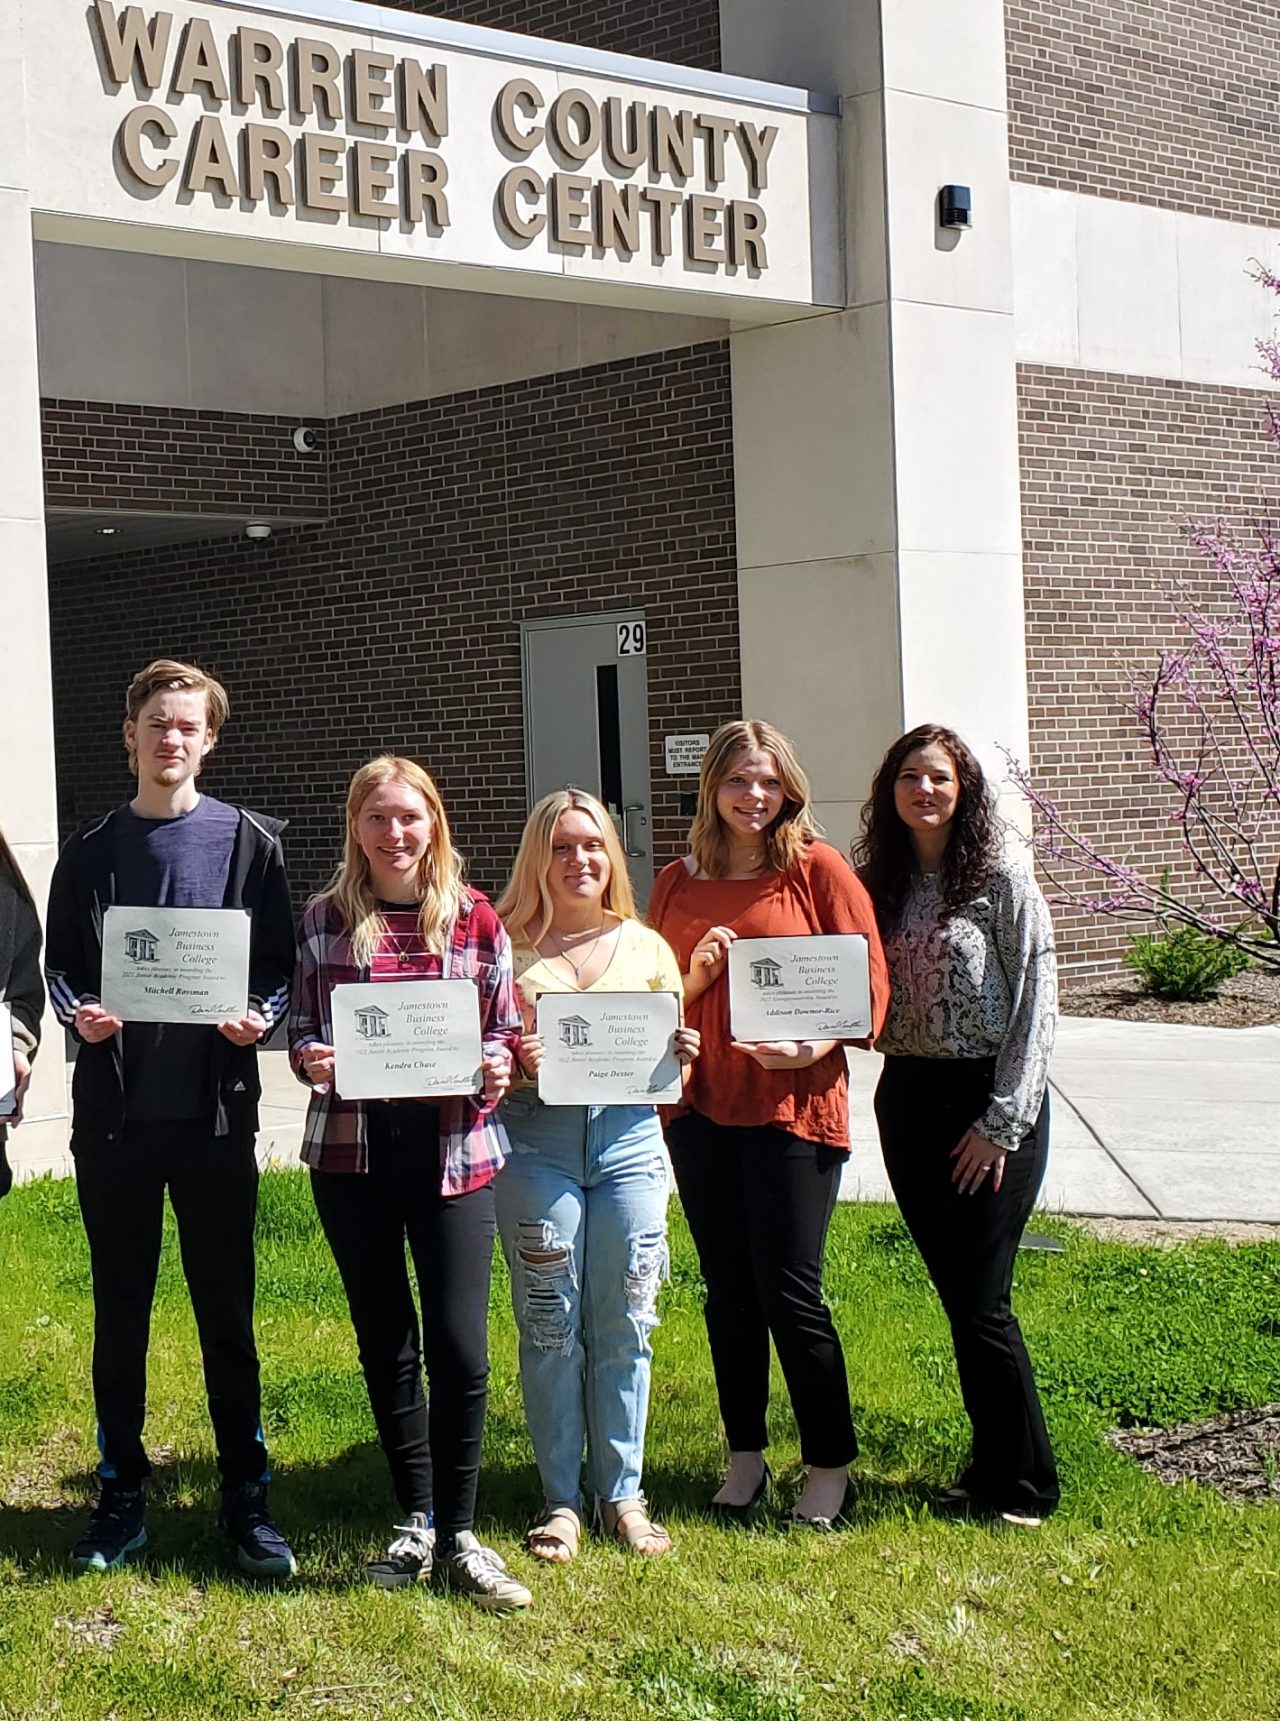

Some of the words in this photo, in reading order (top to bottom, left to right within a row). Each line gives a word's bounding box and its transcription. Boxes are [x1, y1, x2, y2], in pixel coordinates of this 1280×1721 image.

[94, 0, 448, 137] WARREN
[497, 78, 779, 190] COUNTY
[122, 105, 451, 227] CAREER
[500, 165, 769, 269] CENTER
[618, 623, 645, 655] 29
[674, 739, 700, 747] VISITORS
[168, 927, 220, 938] Jamestown
[175, 941, 215, 951] Business
[182, 953, 218, 965] College
[790, 954, 839, 963] Jamestown
[798, 966, 836, 974] Business
[805, 976, 839, 987] College
[143, 986, 174, 995] Mitchell
[398, 1001, 448, 1011] Jamestown
[406, 1014, 445, 1023] Business
[600, 1012, 649, 1021] Jamestown
[413, 1026, 449, 1037] College
[607, 1024, 645, 1034] Business
[614, 1037, 648, 1047] College
[384, 1062, 411, 1070] Kendra
[413, 1061, 436, 1069] Chase
[588, 1070, 608, 1078] Paige
